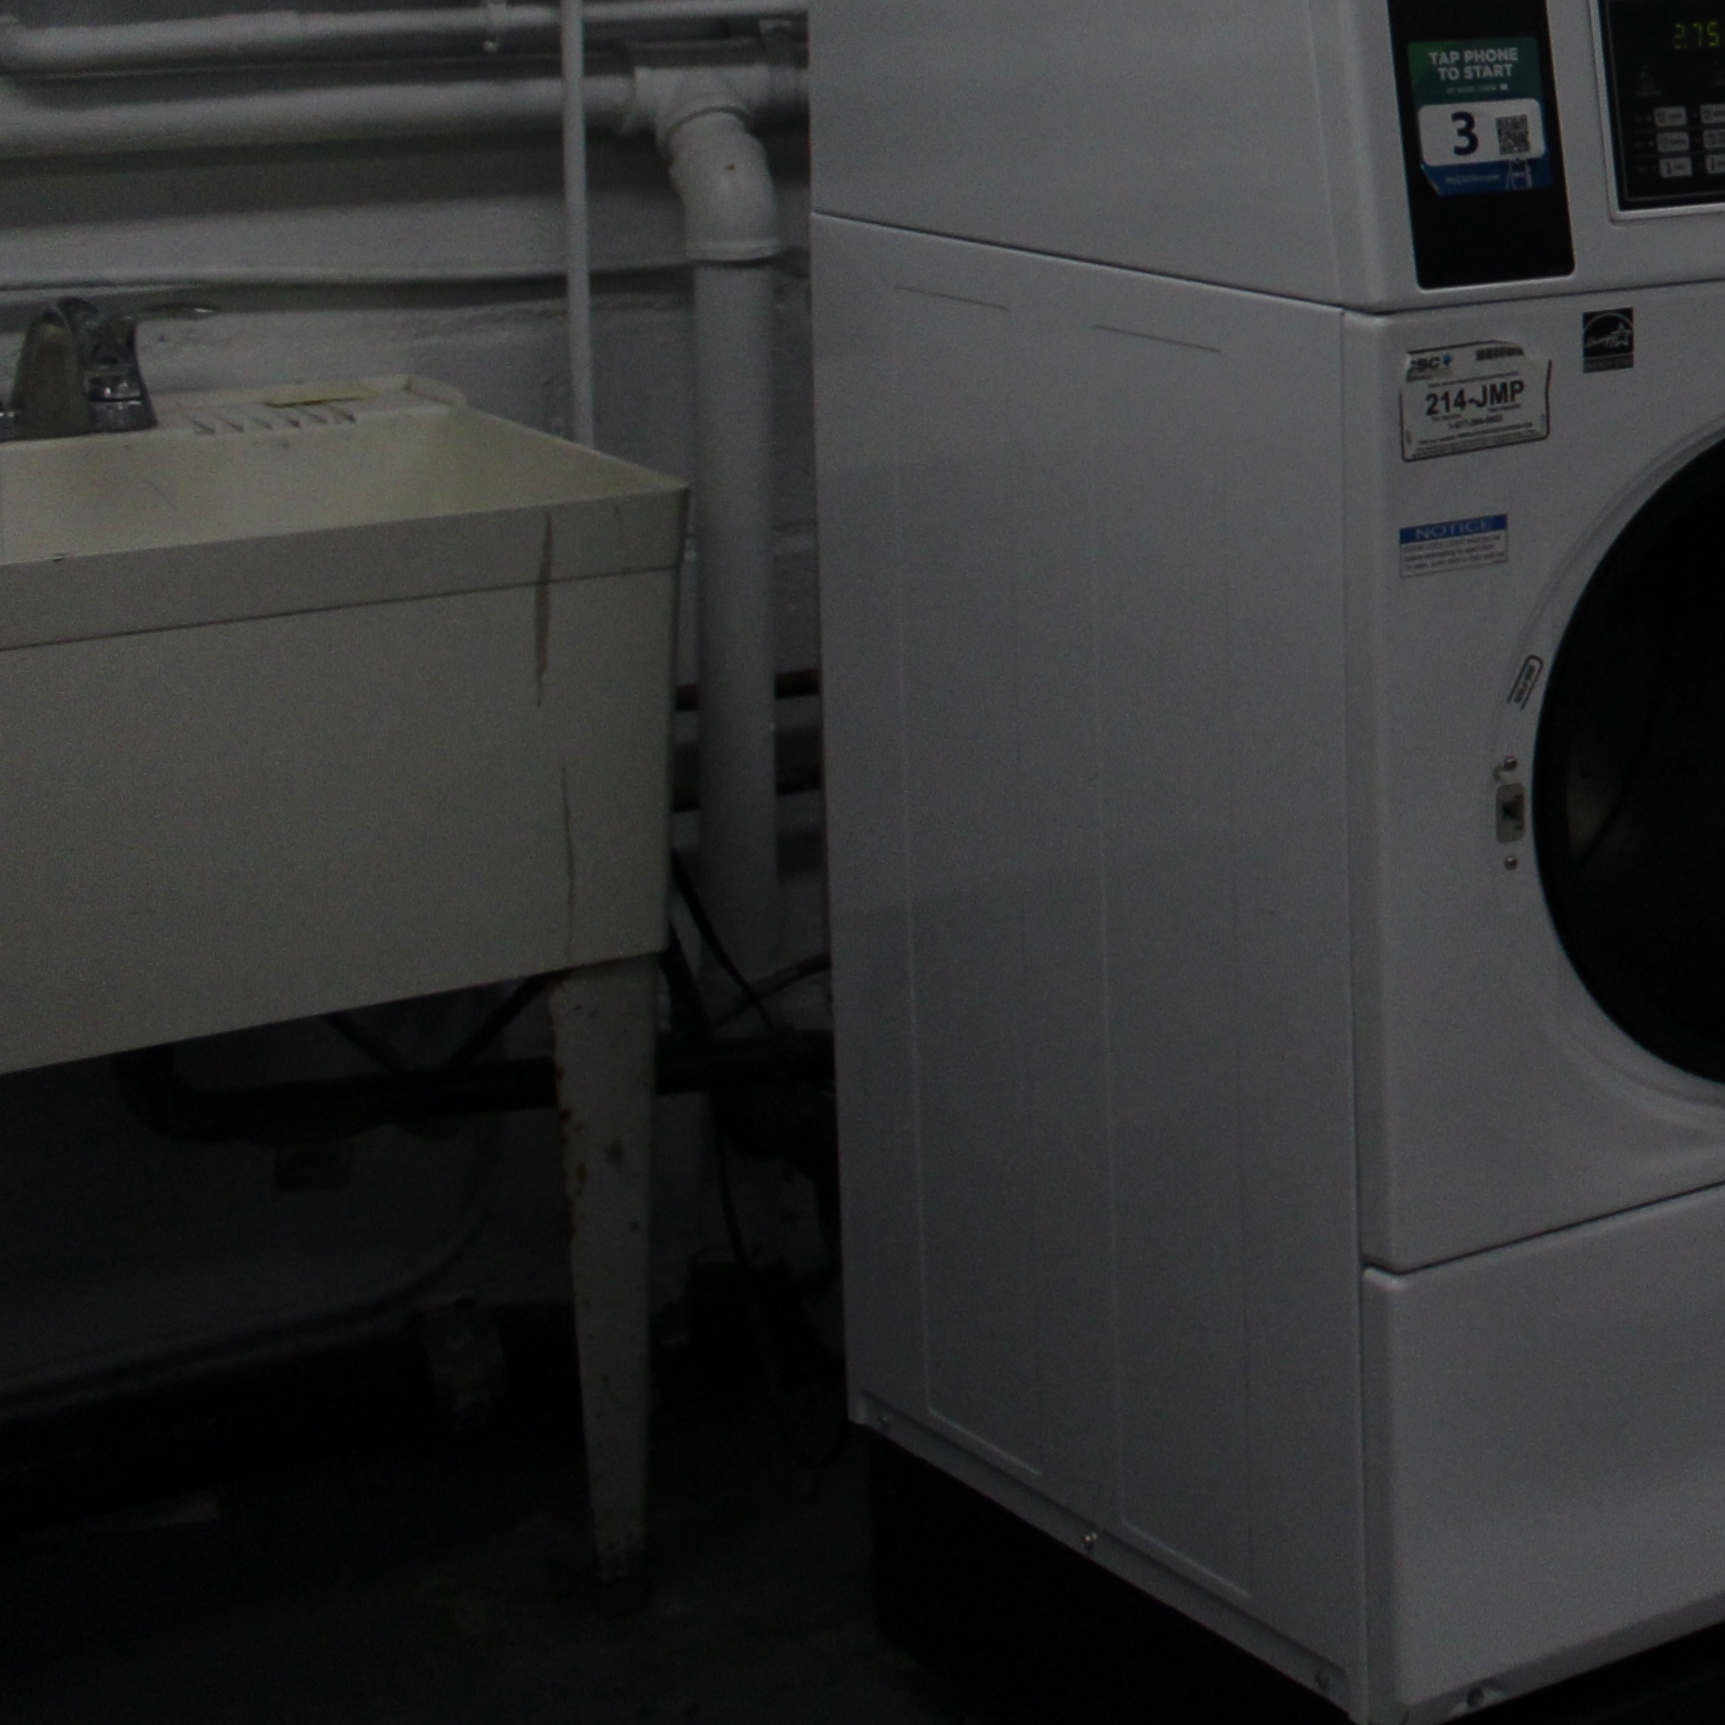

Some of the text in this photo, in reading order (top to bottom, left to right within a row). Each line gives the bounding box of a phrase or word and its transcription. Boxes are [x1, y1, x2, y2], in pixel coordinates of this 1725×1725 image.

[1428, 47, 1519, 66] TAP PHONE
[1436, 63, 1514, 81] TO START
[1451, 111, 1479, 155] 3
[1426, 380, 1525, 416] 214-JMP
[1415, 519, 1493, 540] NOTICE
